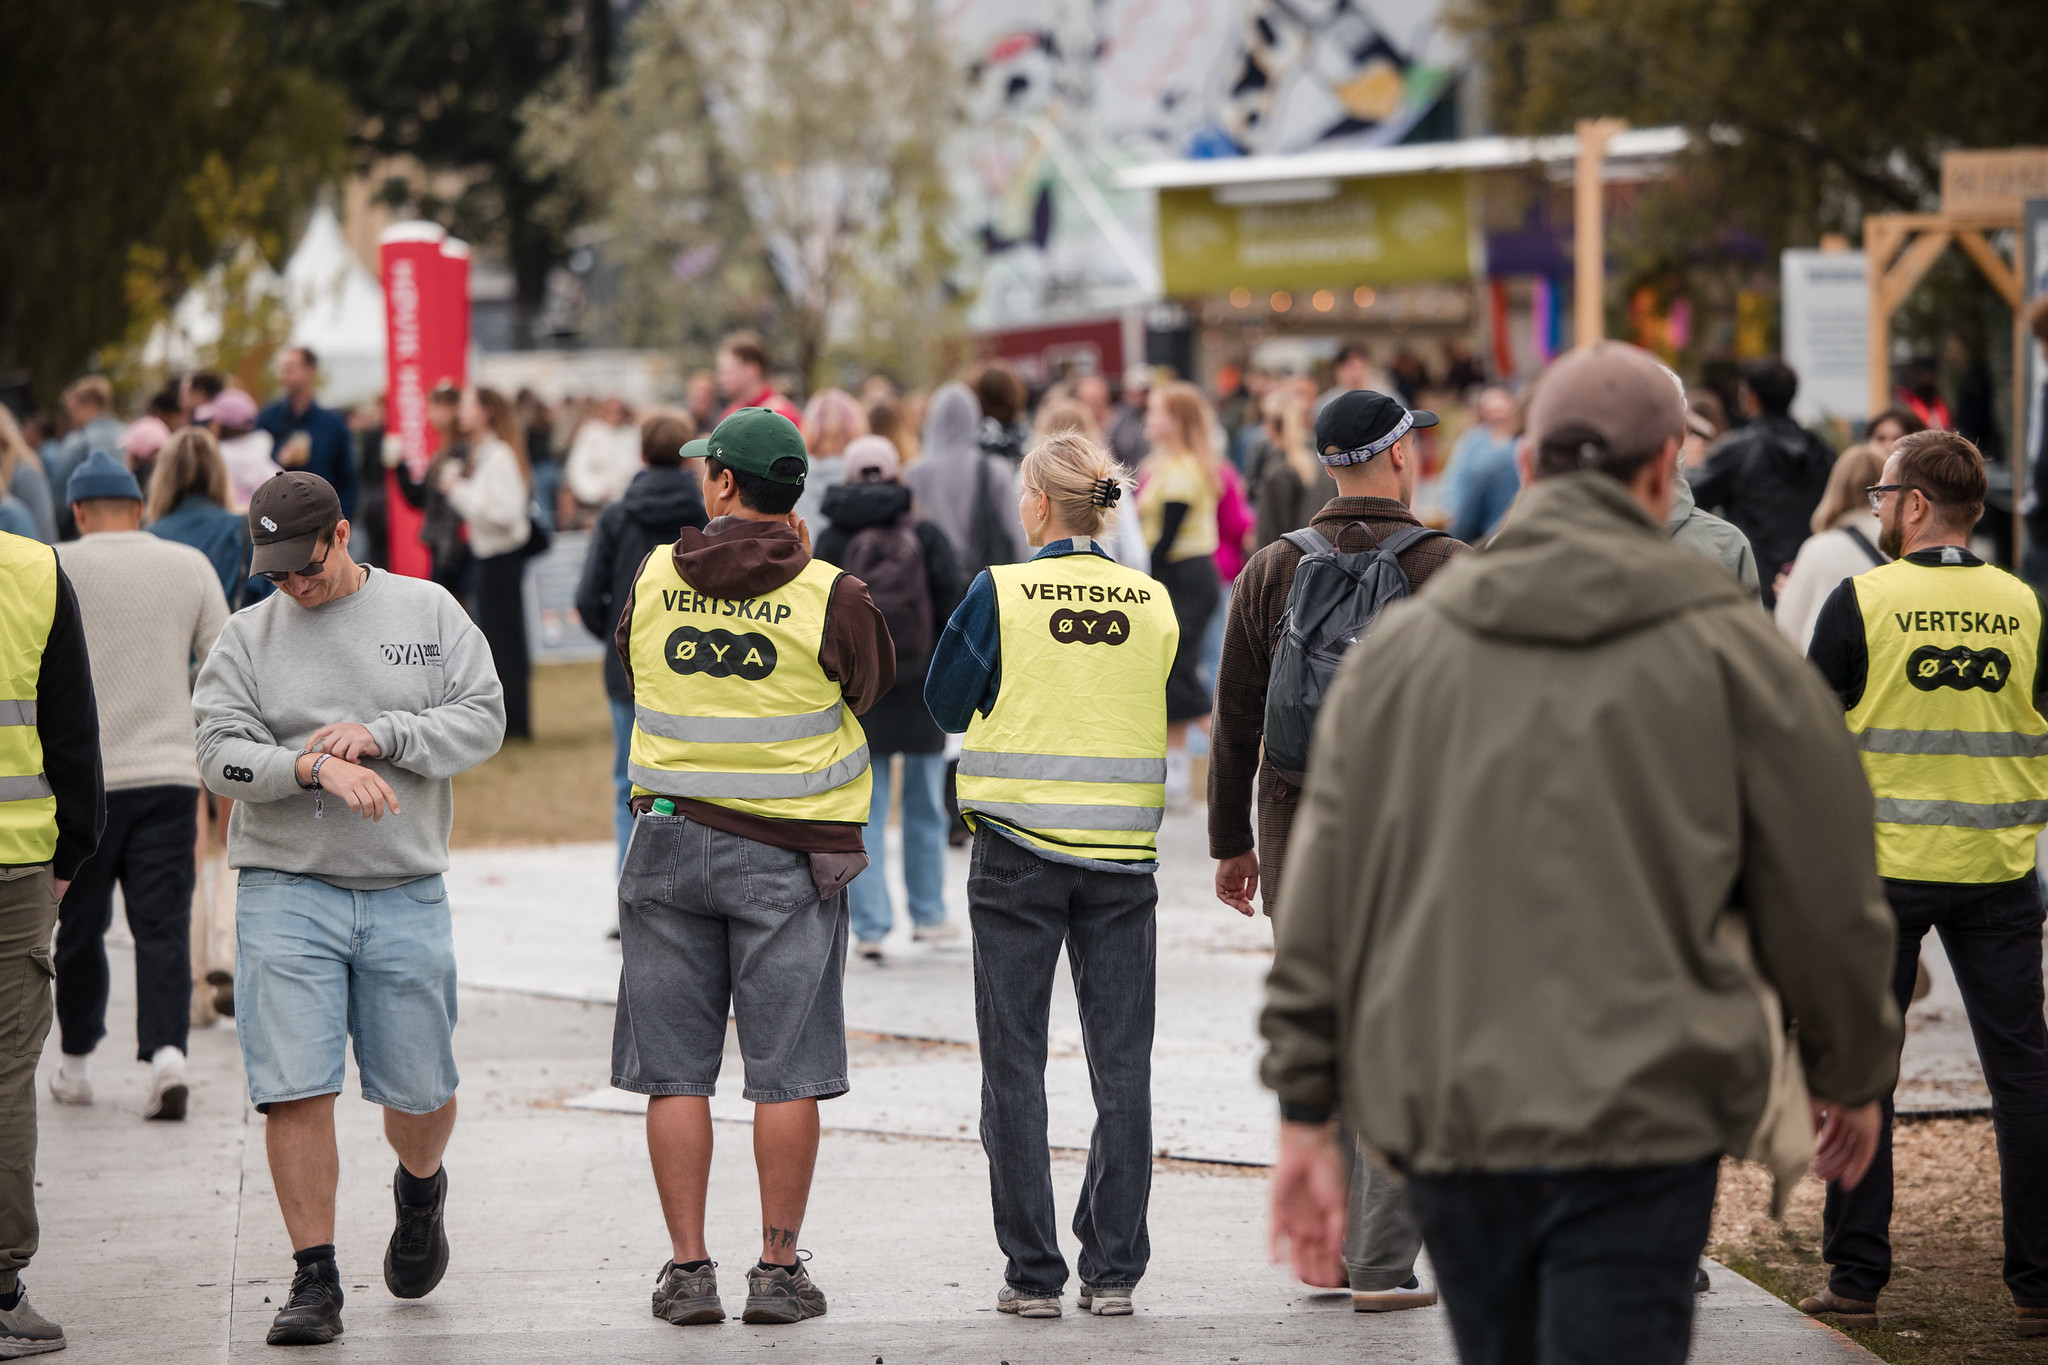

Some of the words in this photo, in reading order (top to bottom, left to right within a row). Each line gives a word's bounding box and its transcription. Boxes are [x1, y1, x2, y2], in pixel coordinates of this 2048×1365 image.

[1020, 583, 1151, 604] VERTSKAP
[1058, 619, 1122, 635] ØYA
[1895, 610, 2020, 636] VERTSKAP
[381, 643, 425, 666] ØYA
[423, 644, 441, 657] 2022
[675, 640, 764, 667] ØYA
[1917, 658, 2000, 681] ØYA
